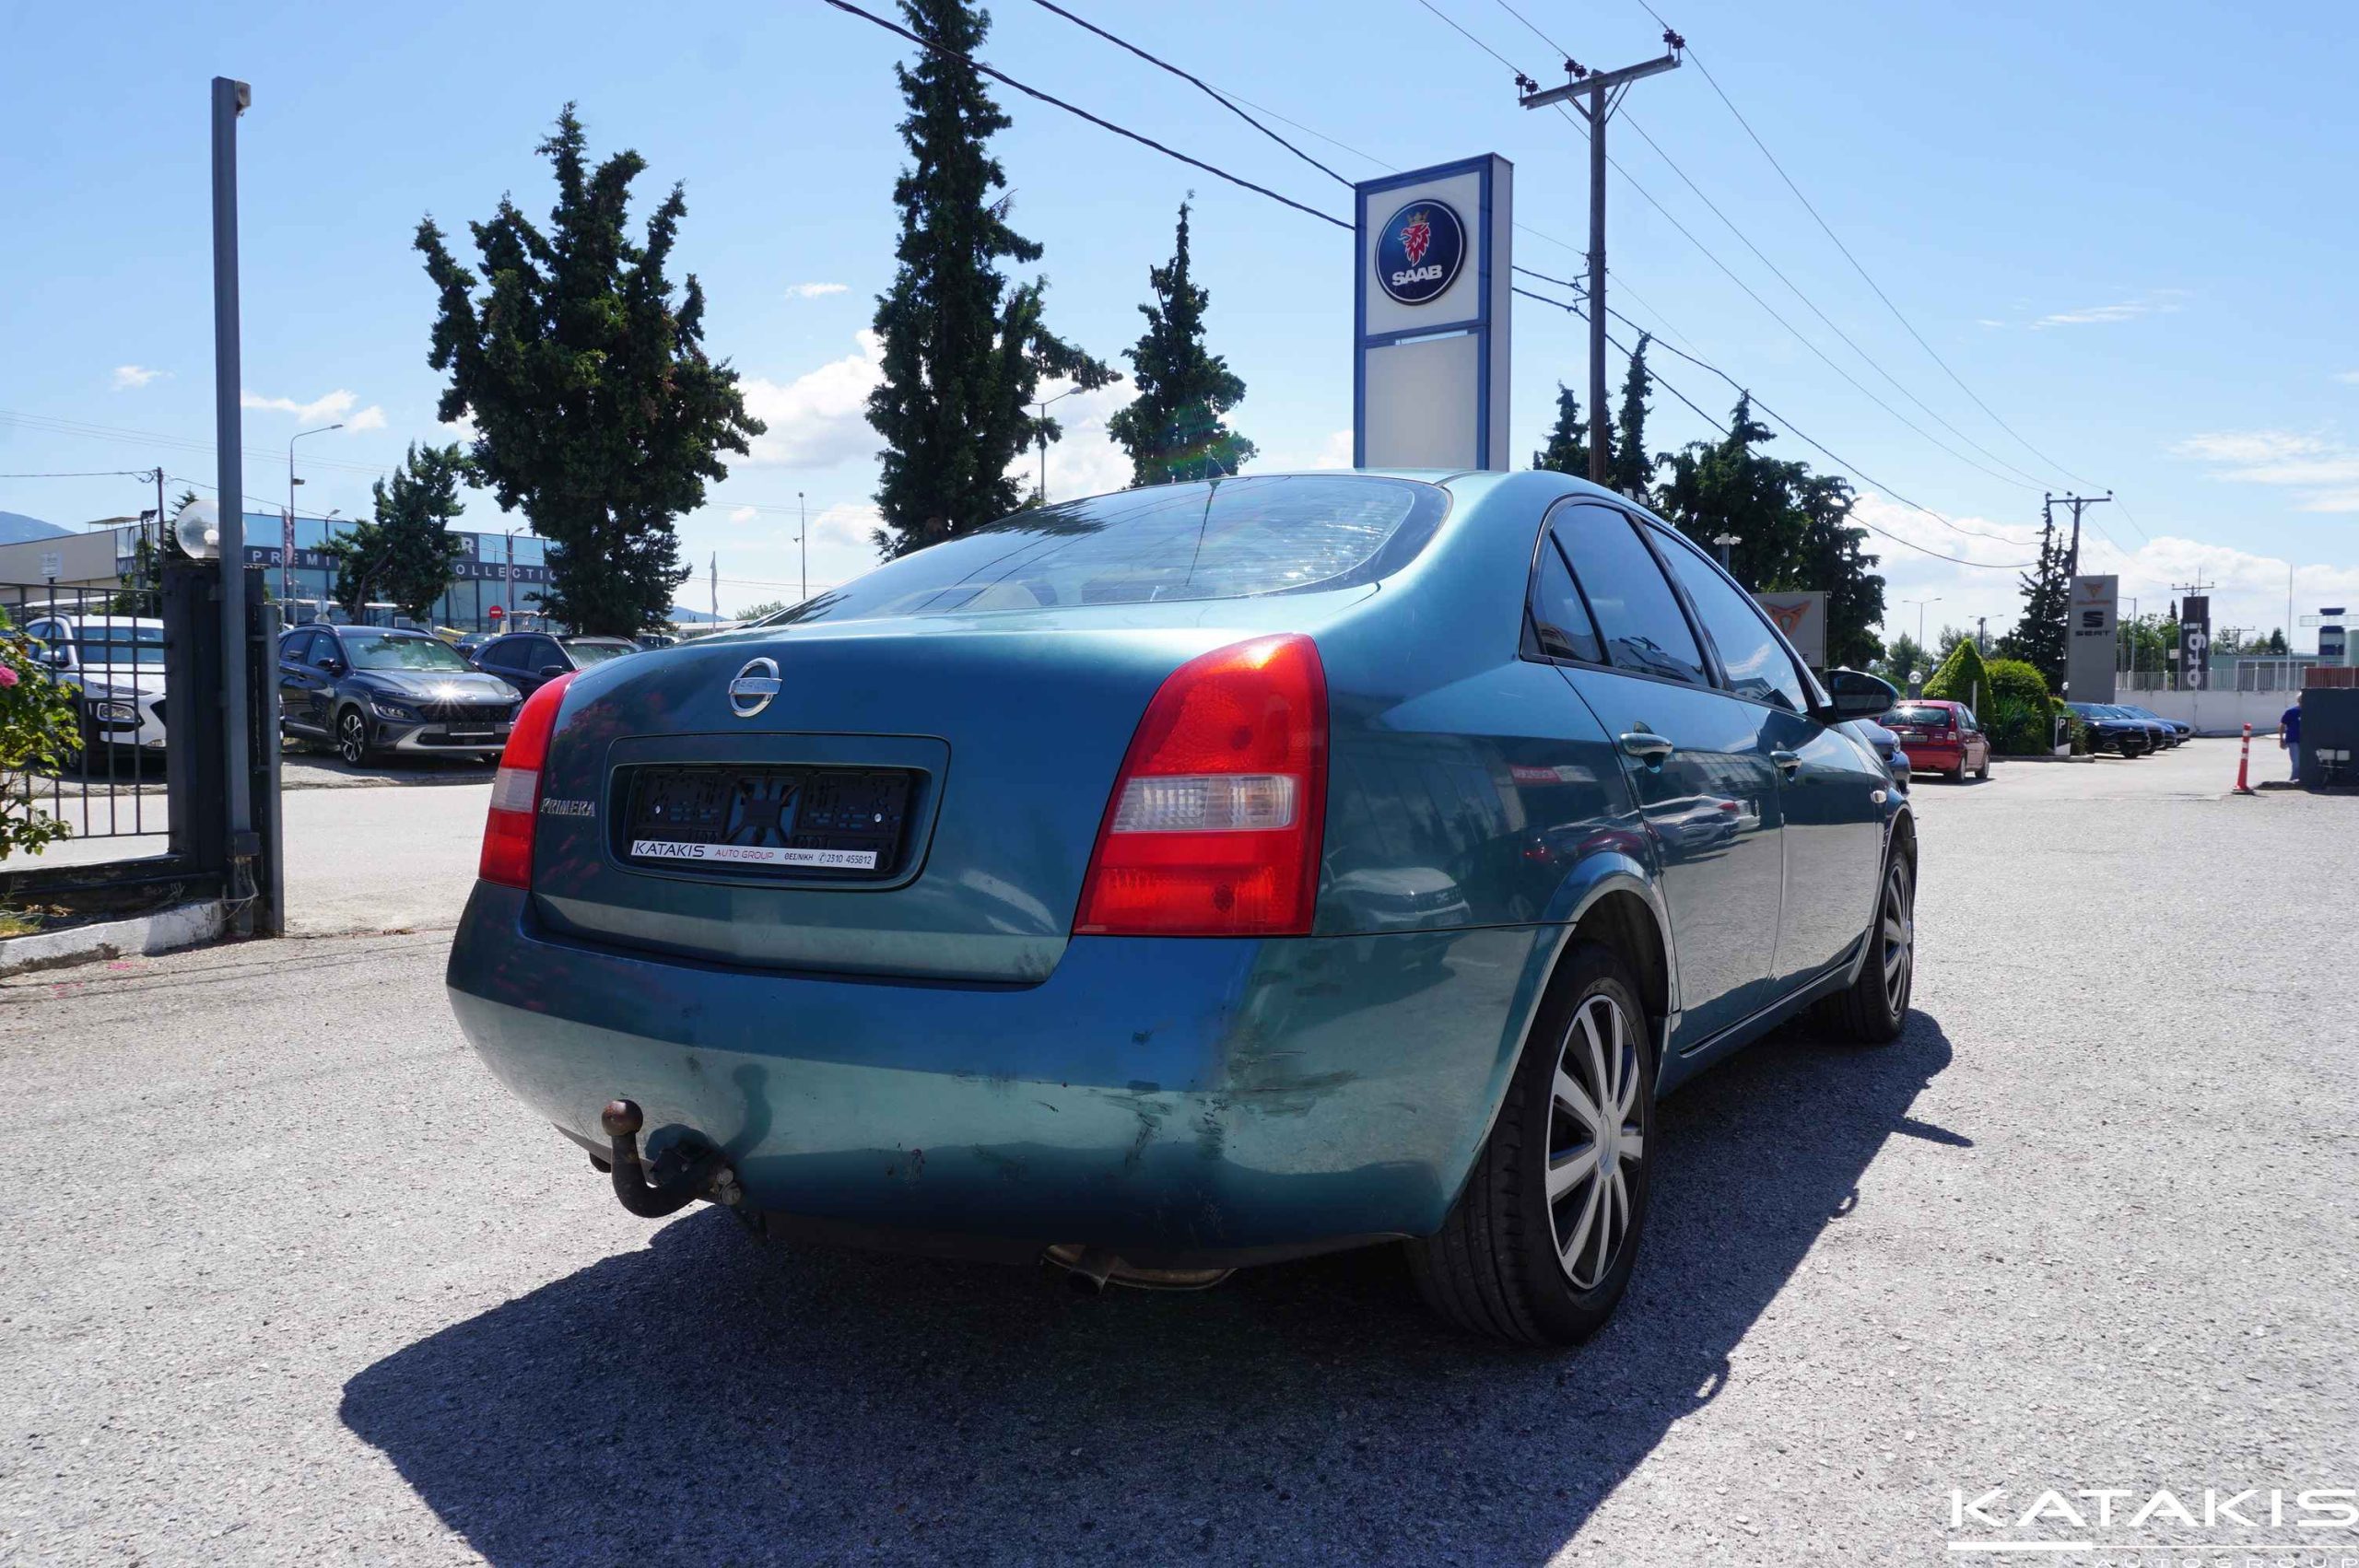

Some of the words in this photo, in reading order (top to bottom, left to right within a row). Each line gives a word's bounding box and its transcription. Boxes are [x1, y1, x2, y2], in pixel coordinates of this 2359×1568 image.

[1391, 264, 1443, 287] SAAB
[252, 550, 331, 566] PREMI
[455, 564, 557, 581] OLLECTIO
[2059, 719, 2066, 730] P
[540, 797, 596, 817] PRIMERA
[634, 841, 706, 858] KATAKIS
[714, 848, 739, 859] AUTO
[741, 849, 775, 860] GROUP
[827, 854, 843, 863] 2310
[845, 855, 873, 865] 455812
